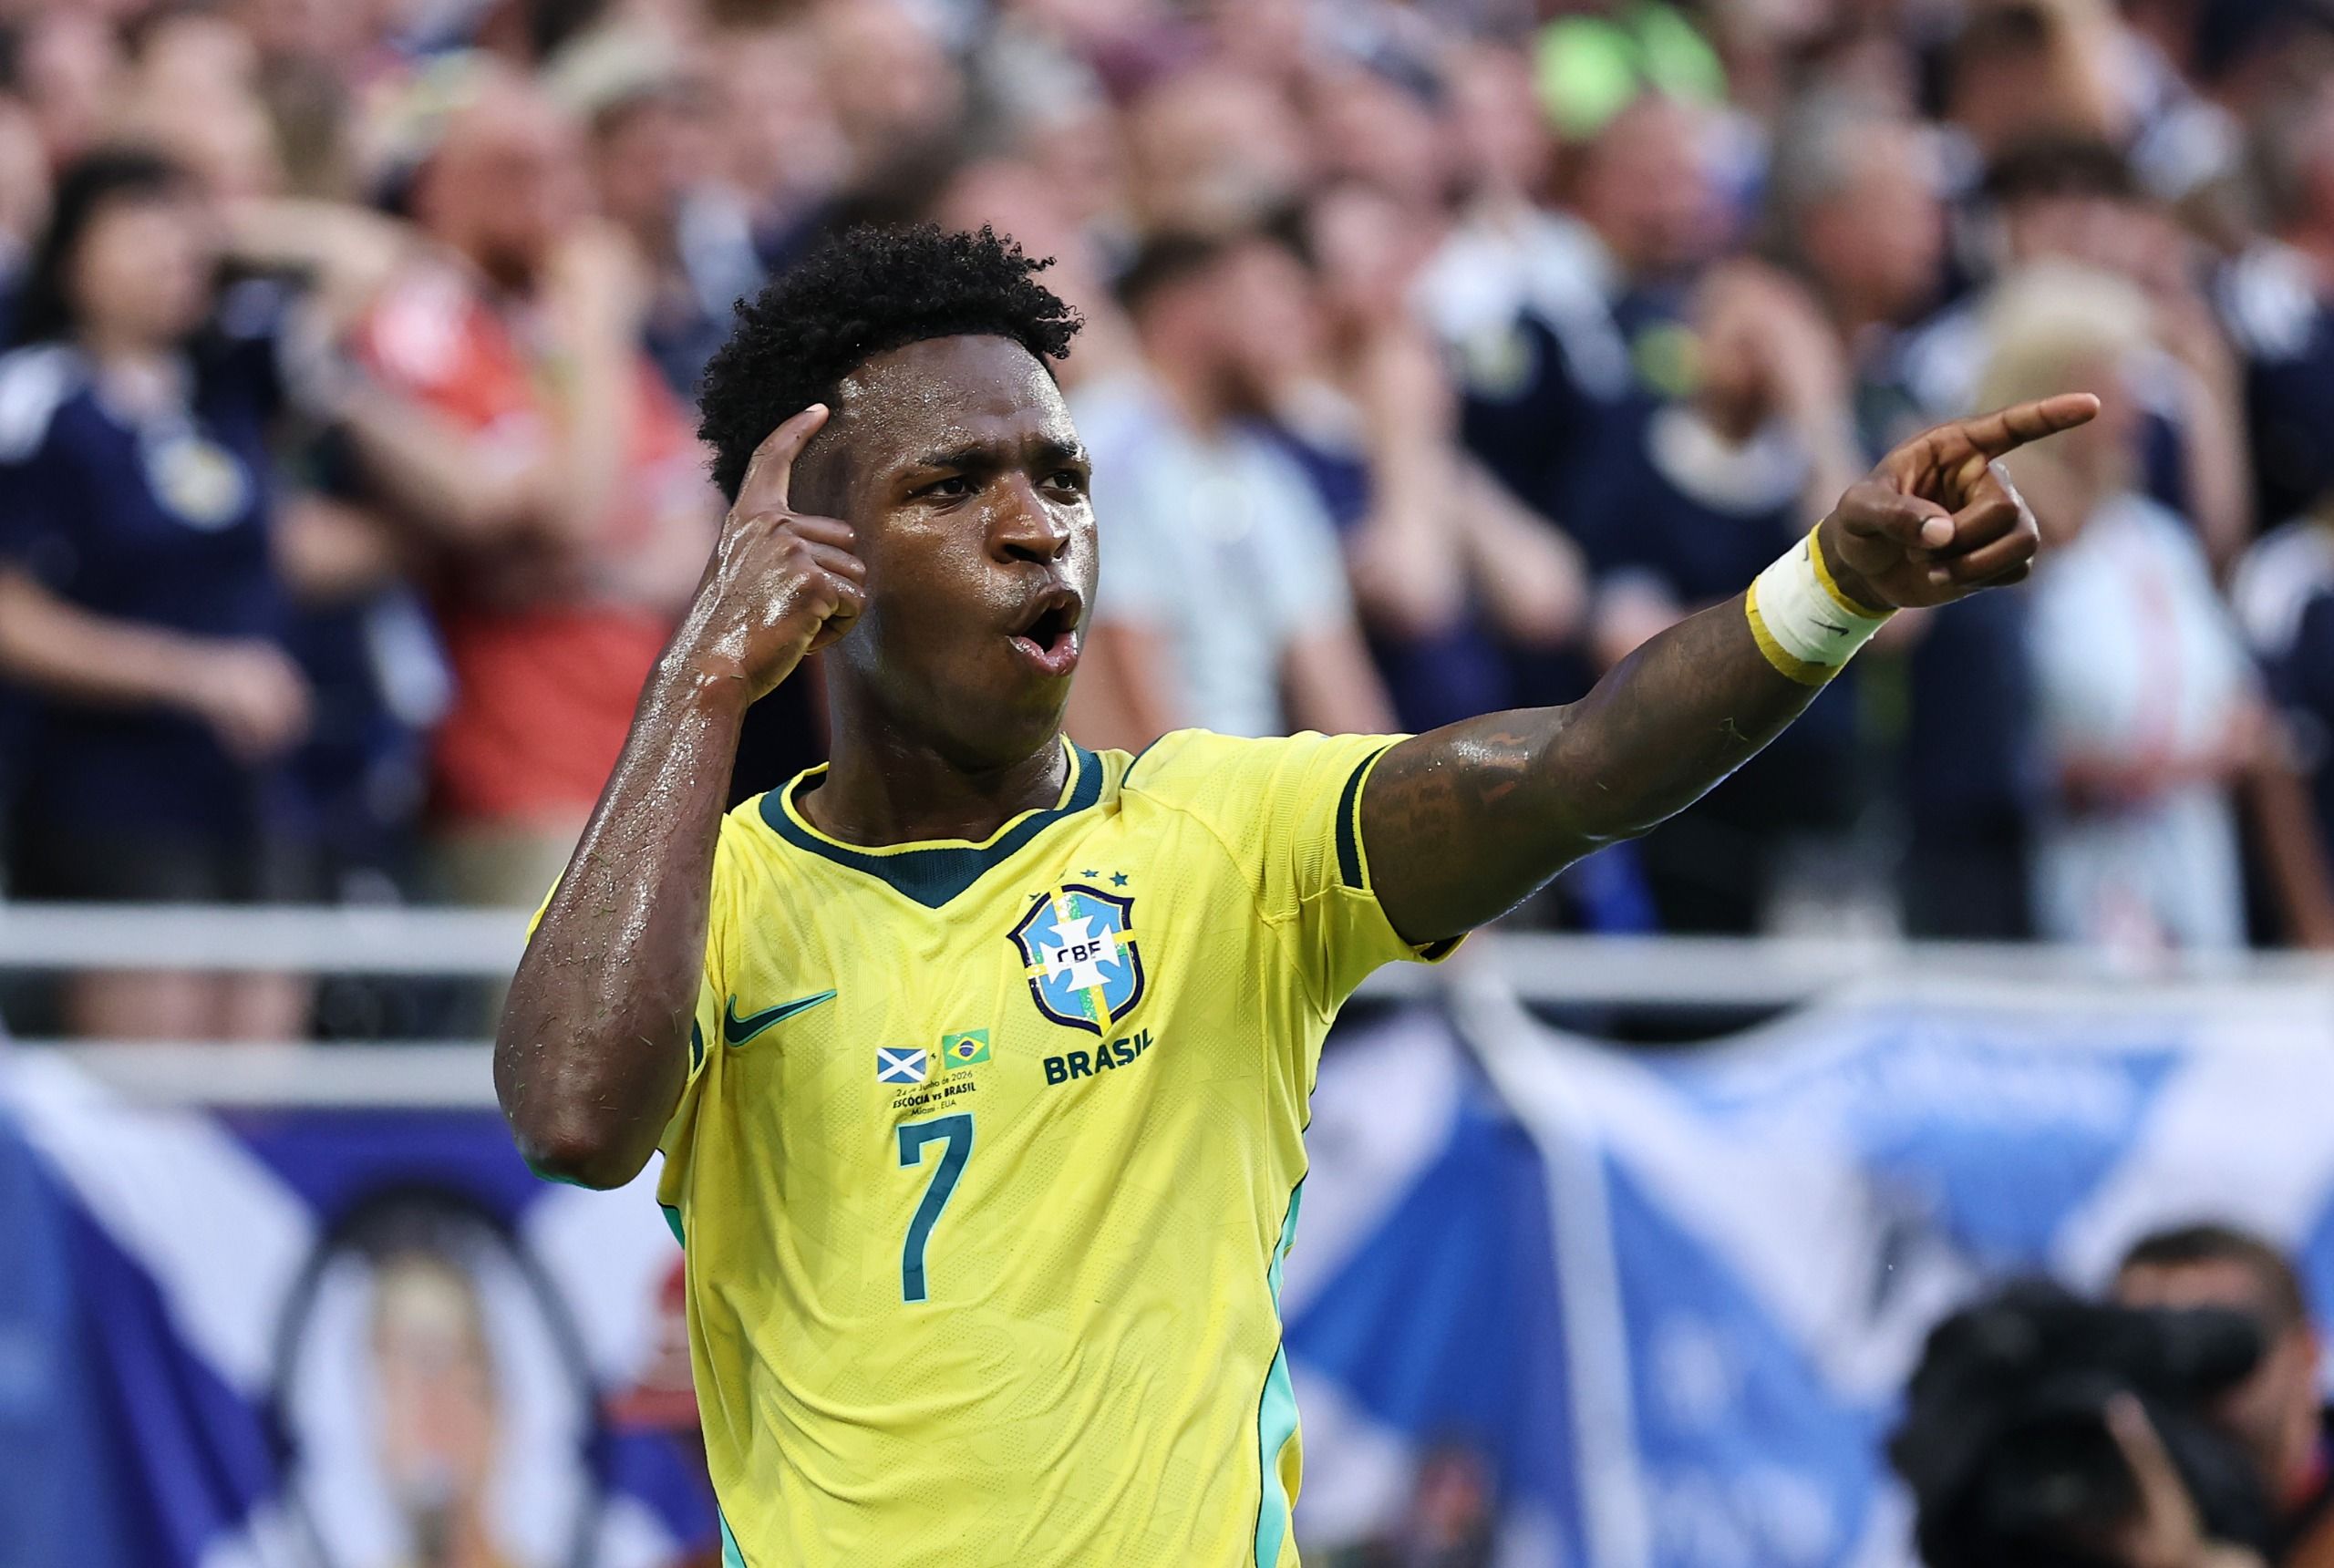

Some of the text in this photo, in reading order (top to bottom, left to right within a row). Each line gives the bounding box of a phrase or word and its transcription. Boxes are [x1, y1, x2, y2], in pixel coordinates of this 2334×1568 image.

[1043, 1027, 1154, 1086] BRASIL
[951, 1070, 973, 1081] 2026
[932, 1092, 942, 1101] vs
[944, 1082, 976, 1097] BRASIL
[911, 1106, 935, 1116] Miami
[940, 1099, 956, 1109] EUA
[897, 1112, 974, 1304] 7
